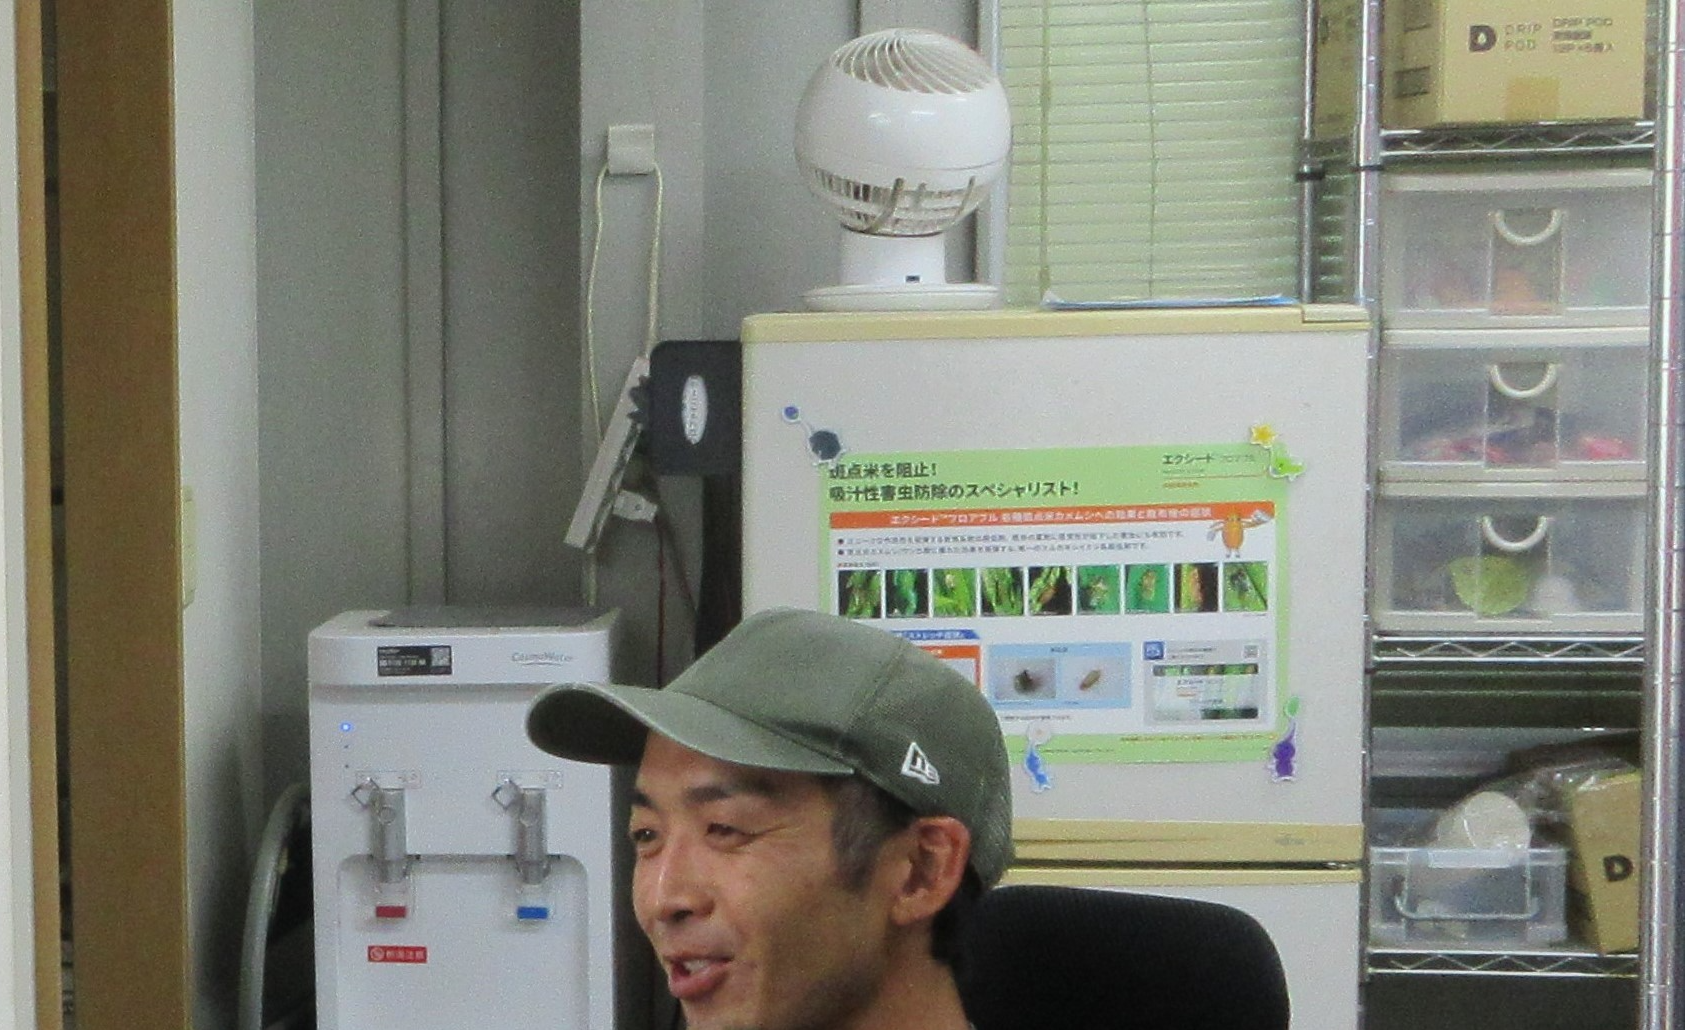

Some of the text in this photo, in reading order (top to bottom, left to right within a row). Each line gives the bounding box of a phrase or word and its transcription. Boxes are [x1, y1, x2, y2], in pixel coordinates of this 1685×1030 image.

[1162, 453, 1214, 465] エクシード
[829, 481, 1079, 502] 吸汁性害虫防除のスペシャリスト!
